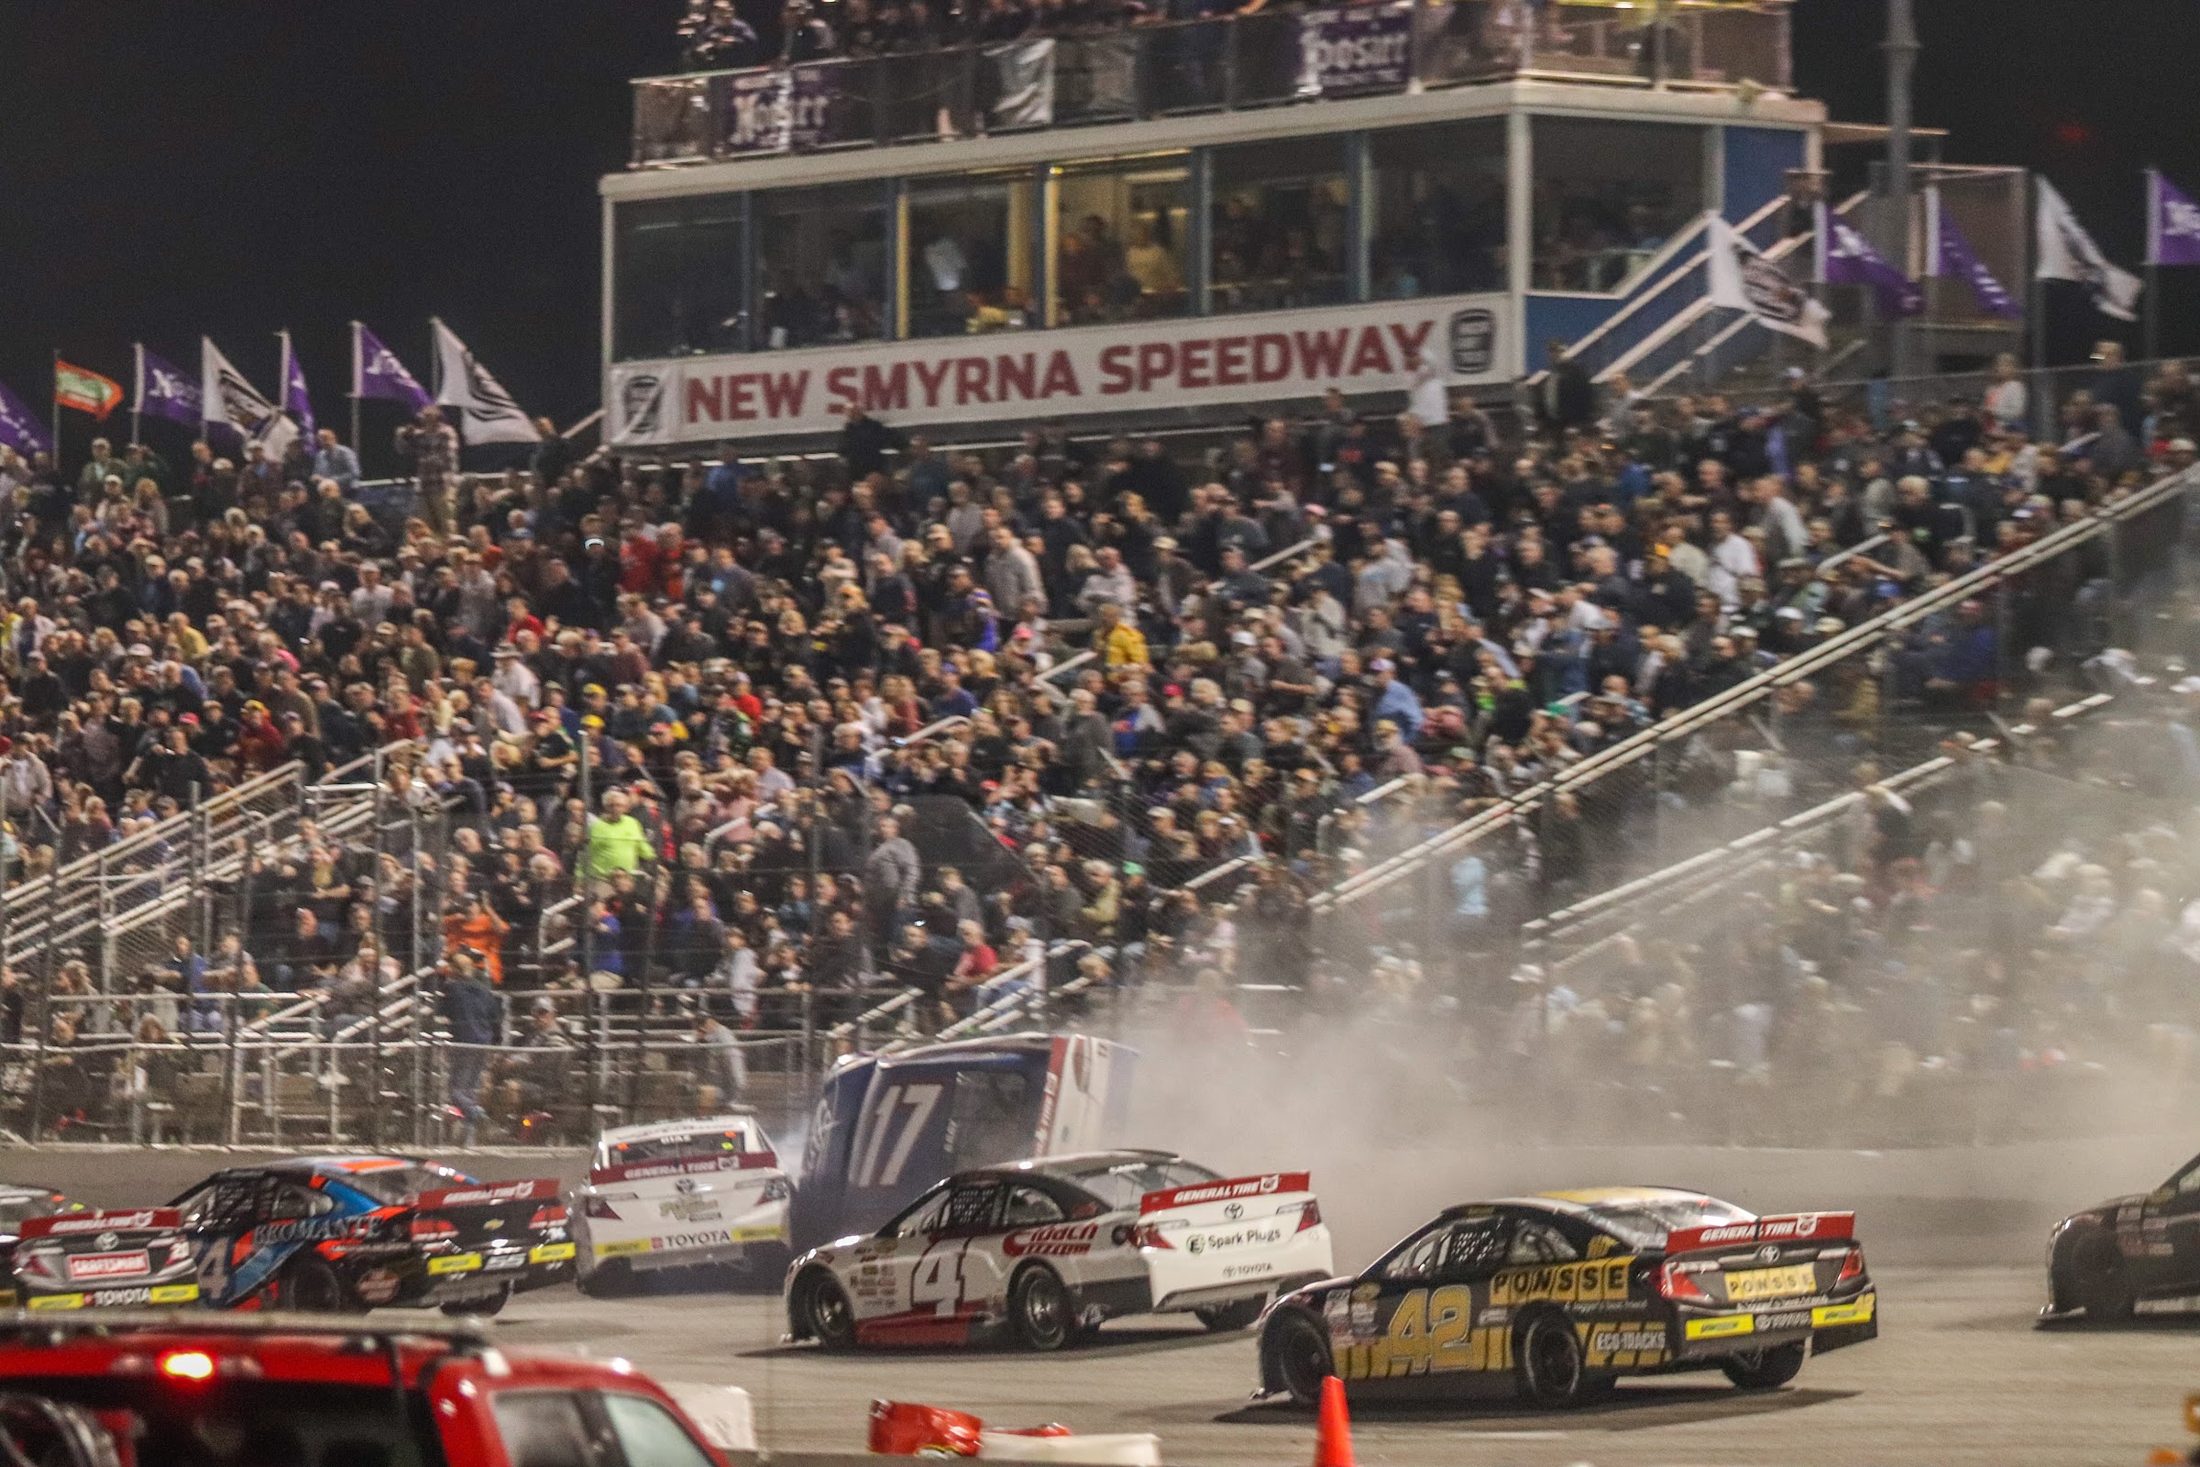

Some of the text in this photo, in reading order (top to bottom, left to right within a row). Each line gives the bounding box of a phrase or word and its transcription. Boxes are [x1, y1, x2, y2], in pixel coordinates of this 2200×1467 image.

[687, 321, 1435, 423] NEW SMYRNA SPEEDWAY
[858, 1084, 945, 1187] 17
[624, 1160, 717, 1179] GENERAL TIRE
[1174, 1181, 1260, 1204] GENERAL TIRE
[666, 1230, 731, 1247] TOYOTA
[1208, 1230, 1242, 1249] Spark
[1245, 1228, 1281, 1243] Plugs
[1700, 1222, 1796, 1243] GENERAL TIRE
[911, 1235, 969, 1318] 4
[1237, 1263, 1273, 1275] TOYOTA
[1492, 1265, 1625, 1295] PONSSE
[1729, 1271, 1814, 1293] PONSSE
[94, 1288, 152, 1307] TOYOTA
[1387, 1284, 1472, 1374] 42
